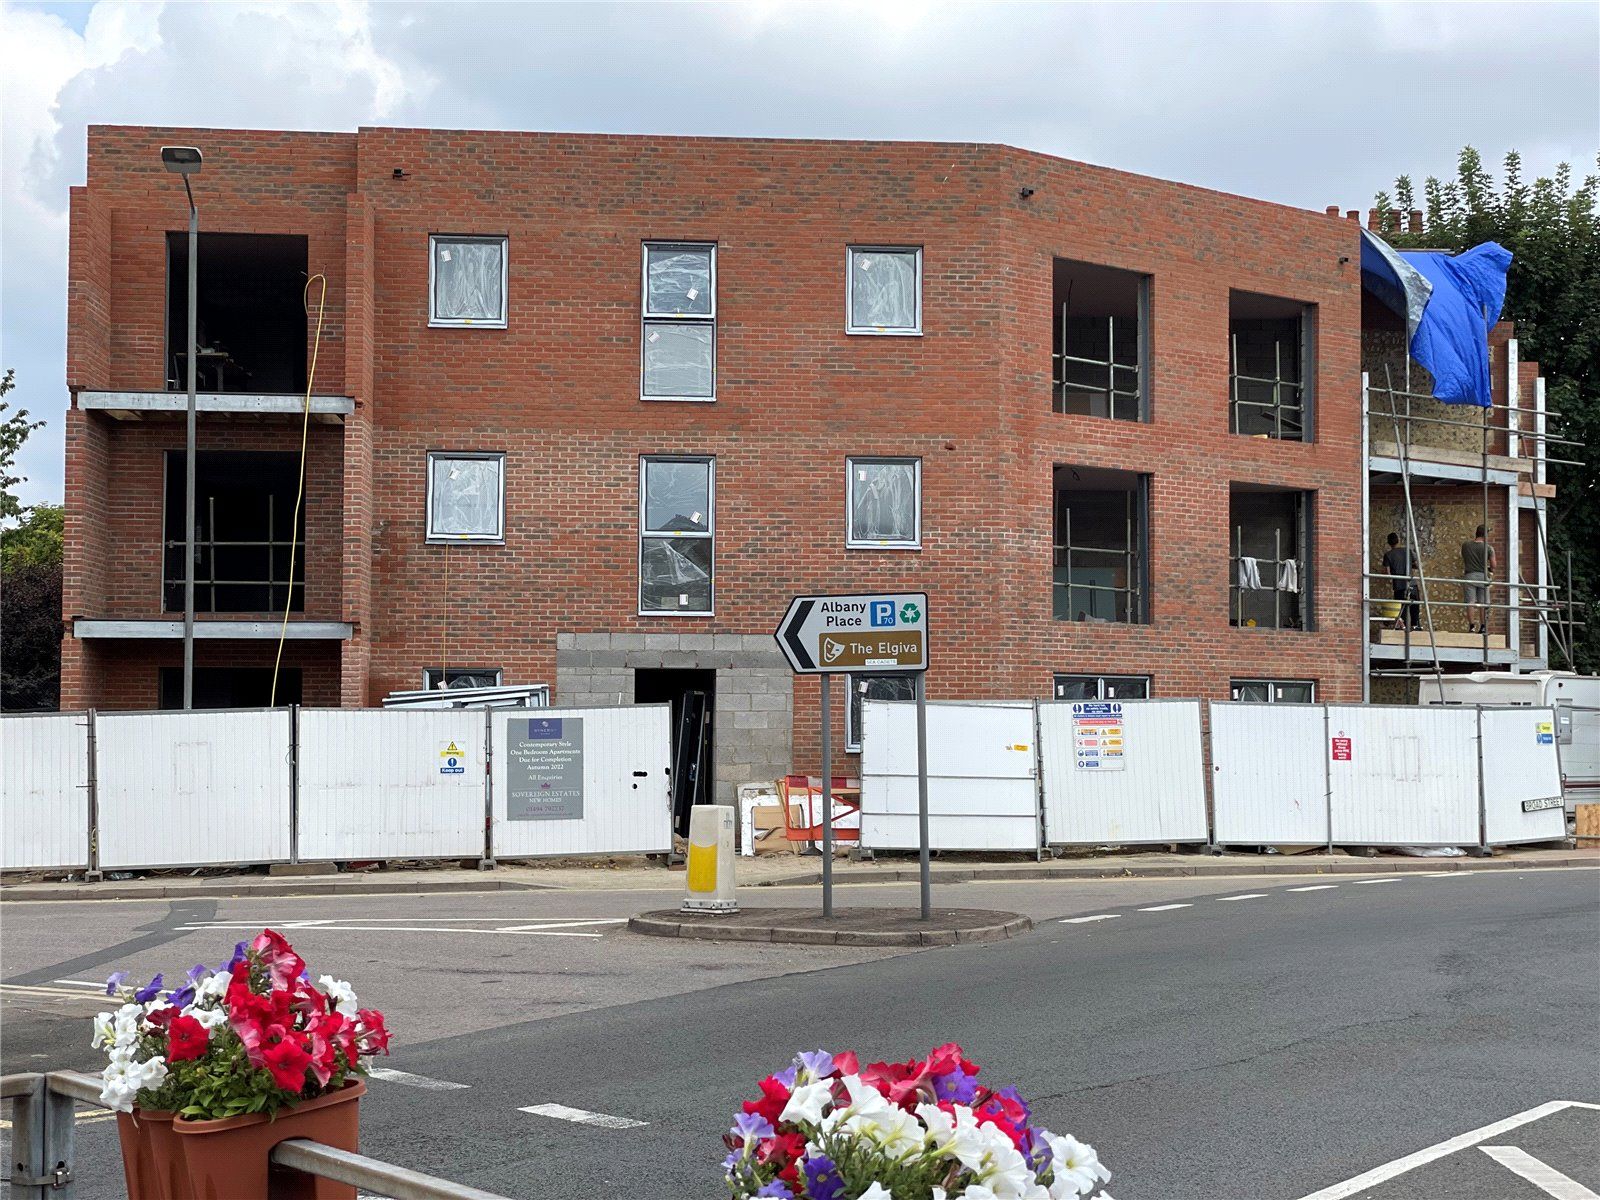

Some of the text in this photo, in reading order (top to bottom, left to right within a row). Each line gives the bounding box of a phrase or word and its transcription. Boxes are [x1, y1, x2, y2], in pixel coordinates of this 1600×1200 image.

[820, 602, 866, 613] Albany
[876, 604, 891, 624] P
[826, 616, 862, 627] Place
[850, 642, 917, 656] The Elgiva
[1525, 797, 1563, 810] BROAD STREET
